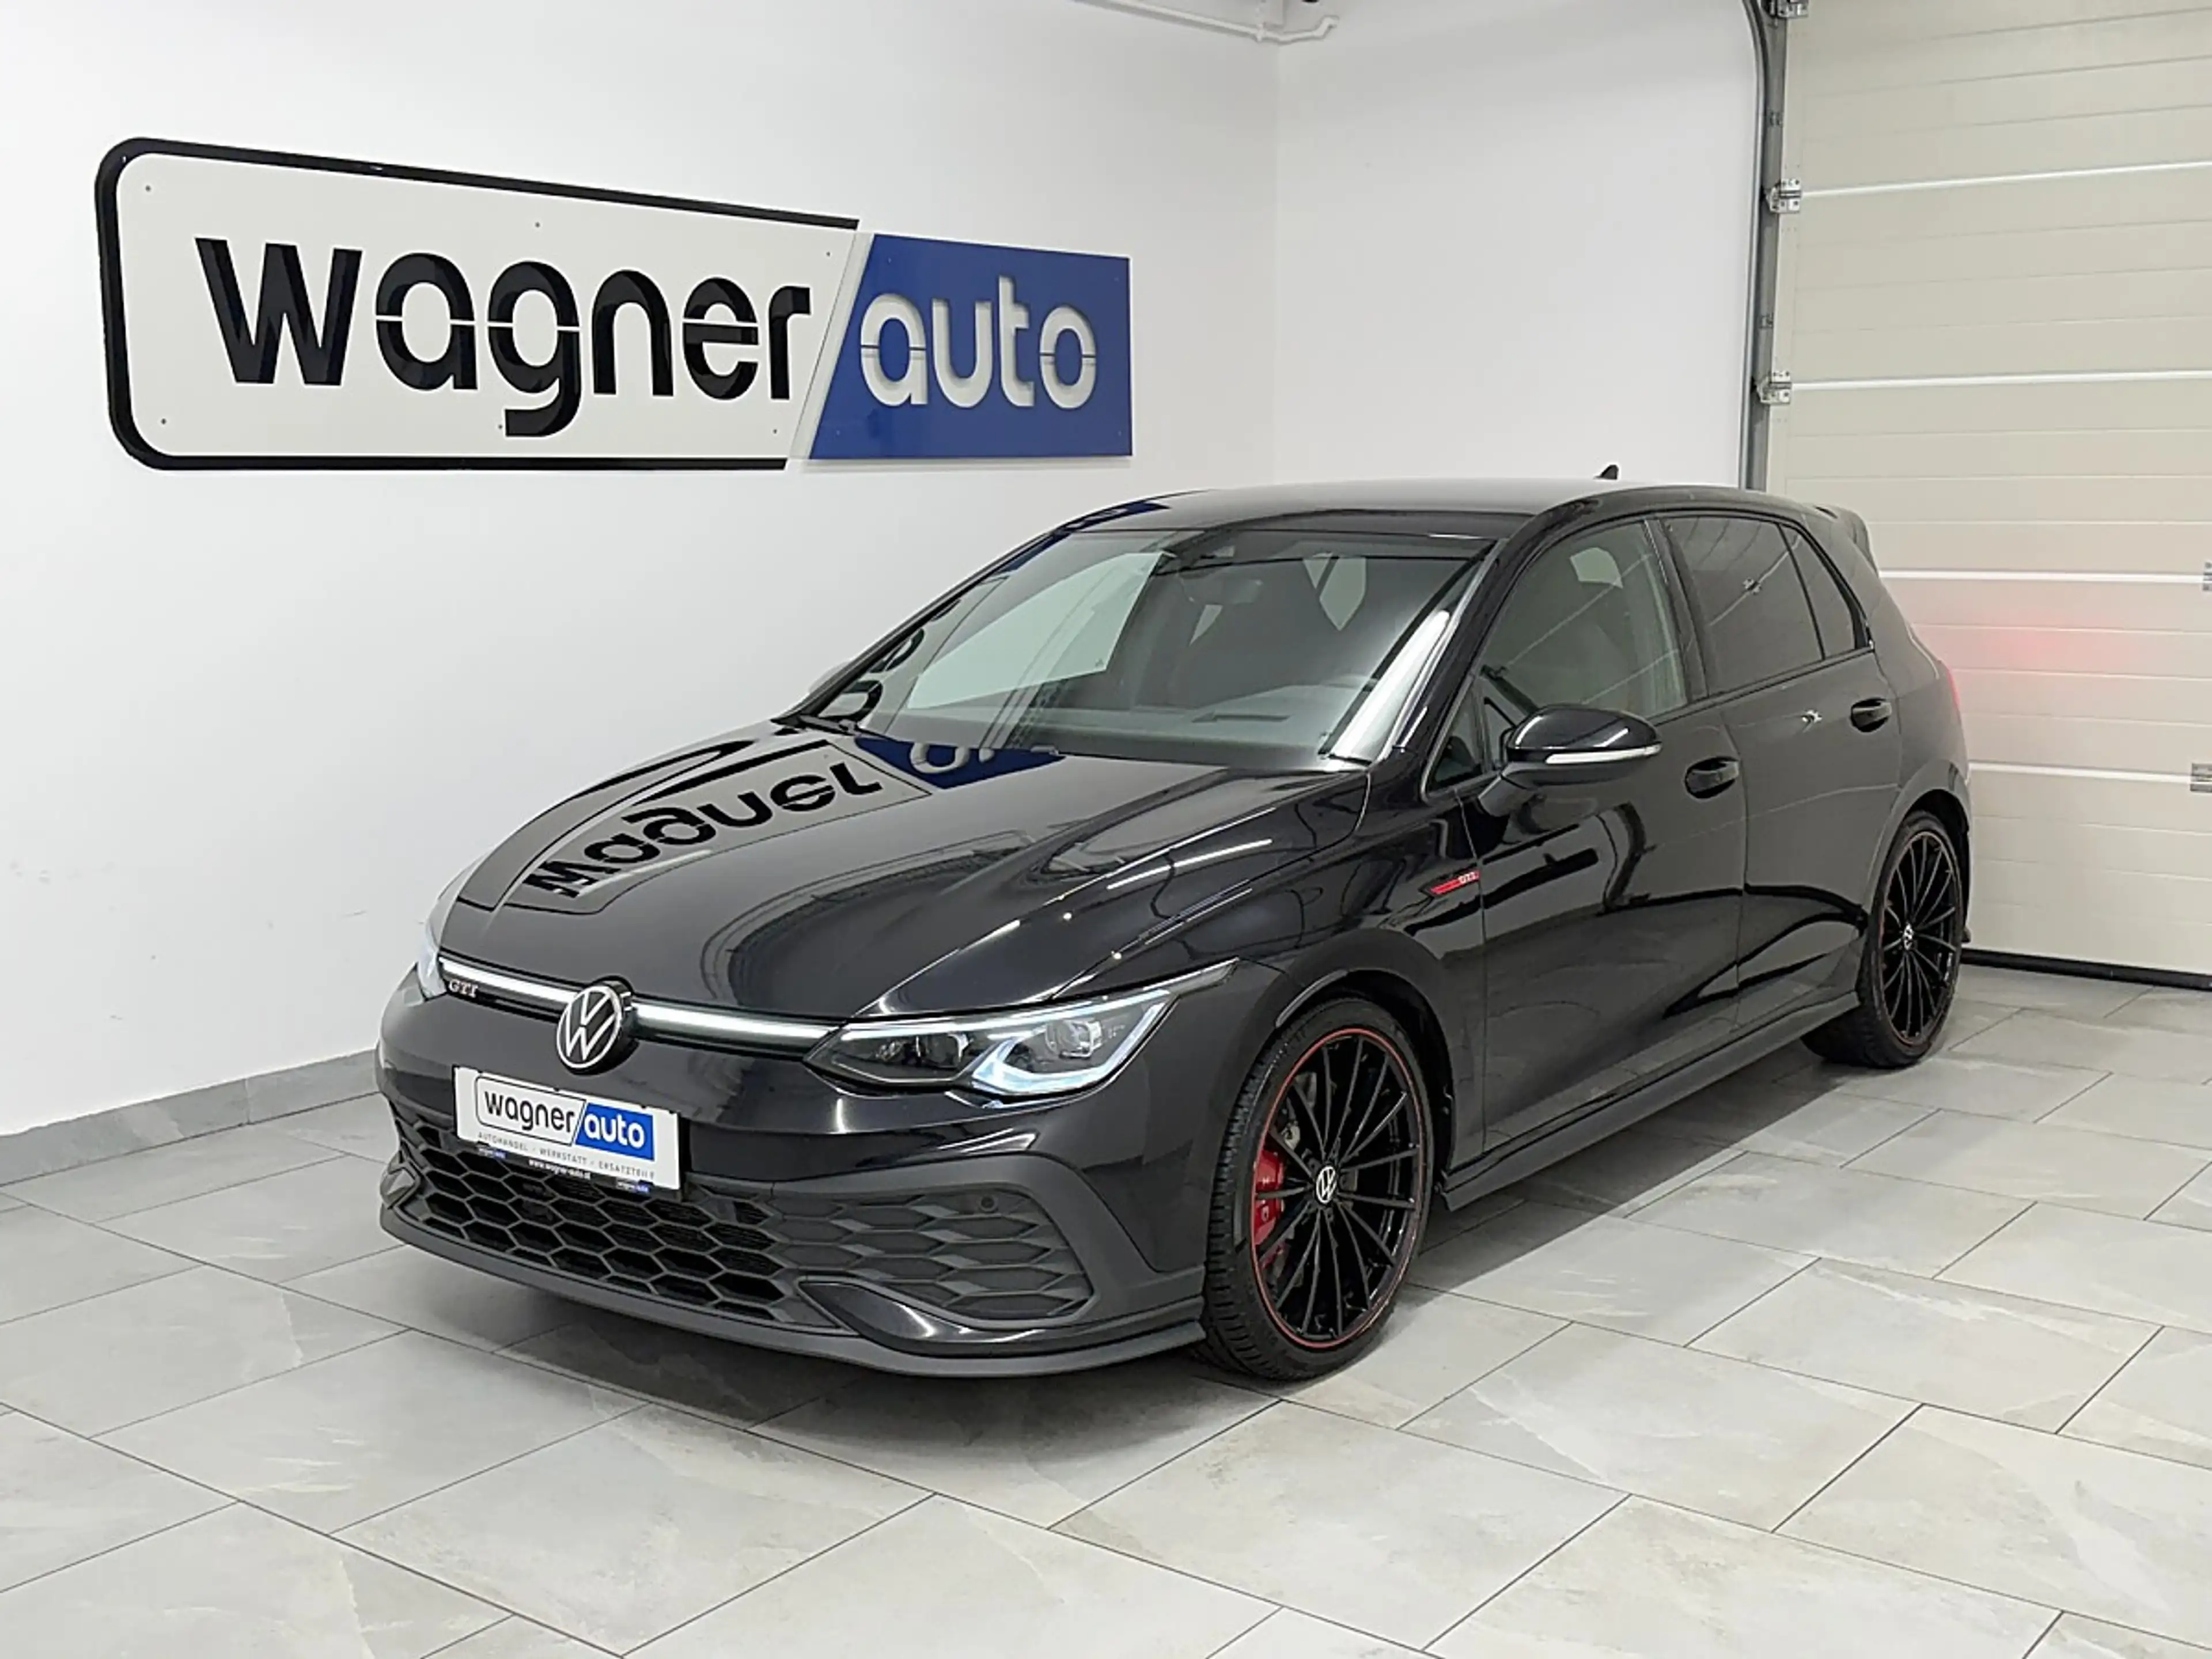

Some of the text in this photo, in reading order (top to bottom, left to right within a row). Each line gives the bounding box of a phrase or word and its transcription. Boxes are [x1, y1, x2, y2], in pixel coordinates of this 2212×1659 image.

[195, 237, 1096, 437] wagner auto
[449, 979, 479, 998] GTI
[484, 1091, 645, 1149] wagner auto
[478, 1131, 528, 1152] AUTOHANDEL
[539, 1148, 587, 1165] WERKSTATT
